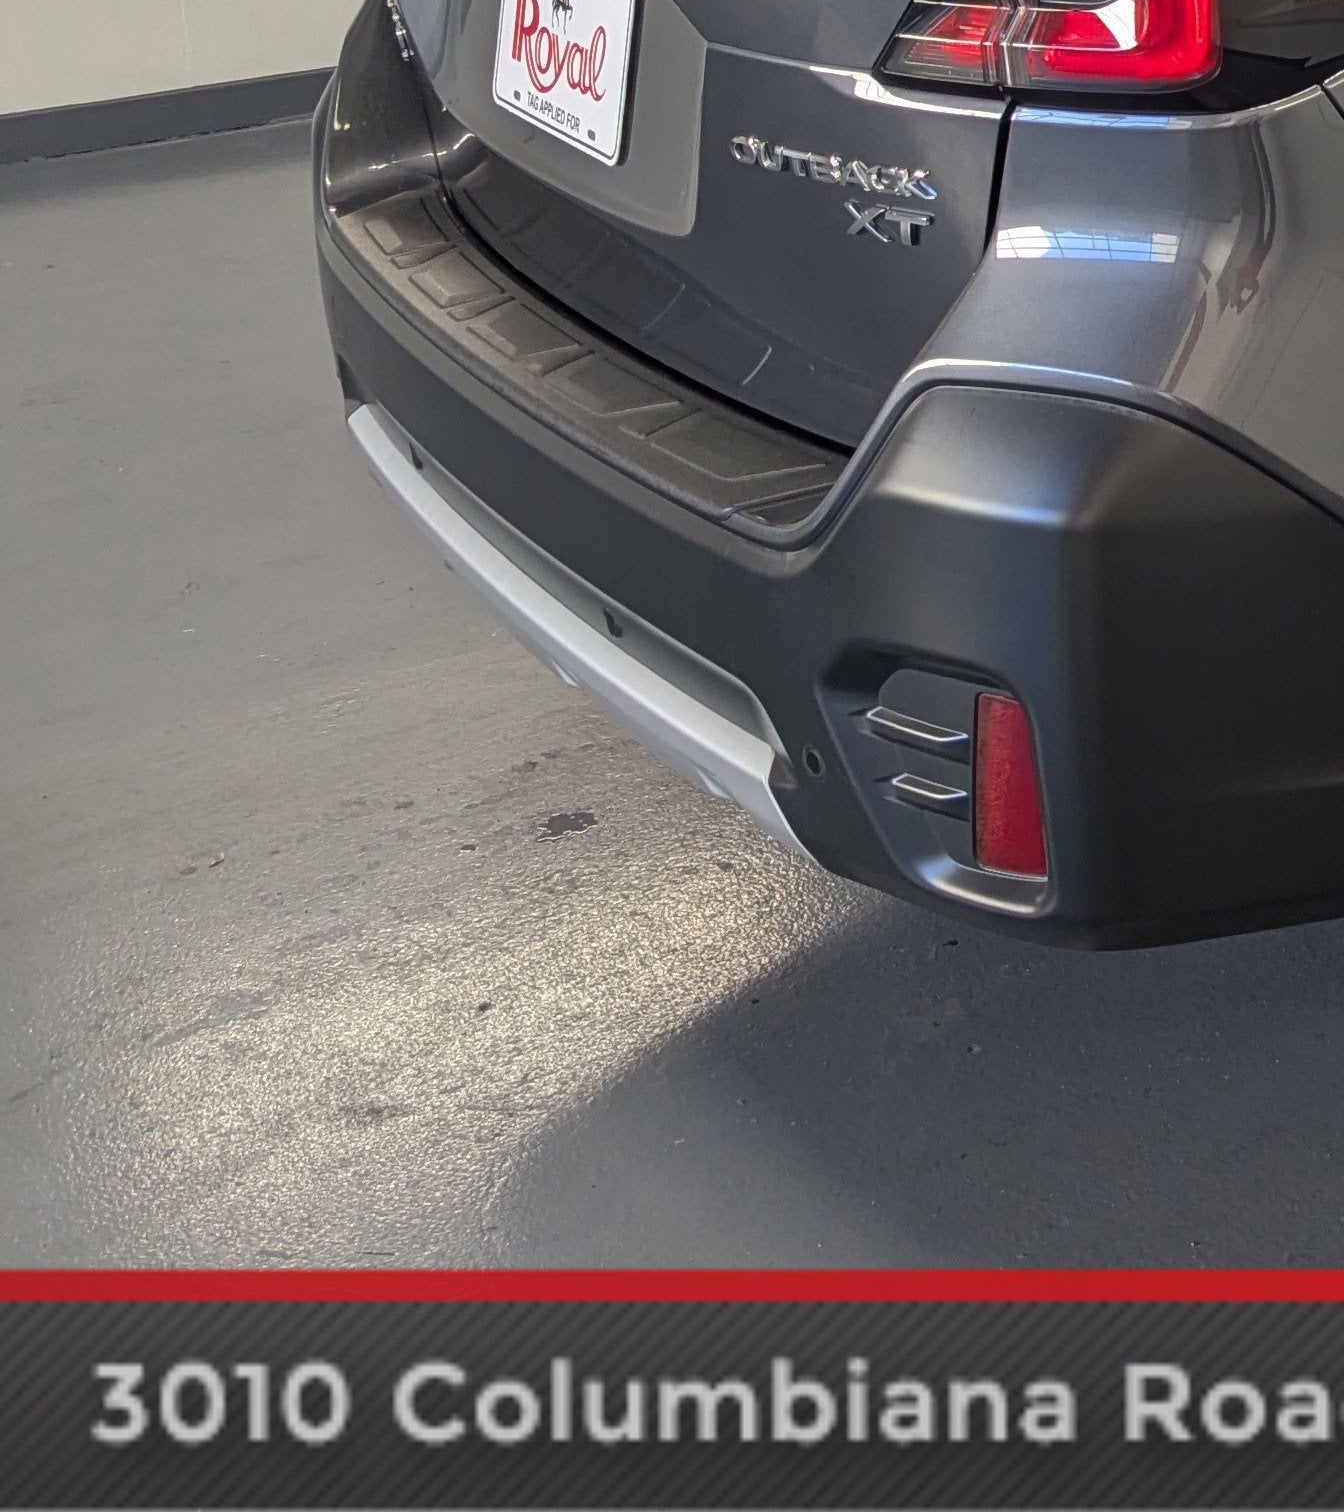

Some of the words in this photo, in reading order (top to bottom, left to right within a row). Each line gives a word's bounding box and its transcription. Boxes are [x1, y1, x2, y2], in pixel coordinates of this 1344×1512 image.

[527, 90, 539, 110] TAG
[539, 99, 565, 125] APPLIED
[566, 112, 580, 133] FOR
[728, 133, 938, 200] OUTBACK
[843, 197, 936, 248] XT
